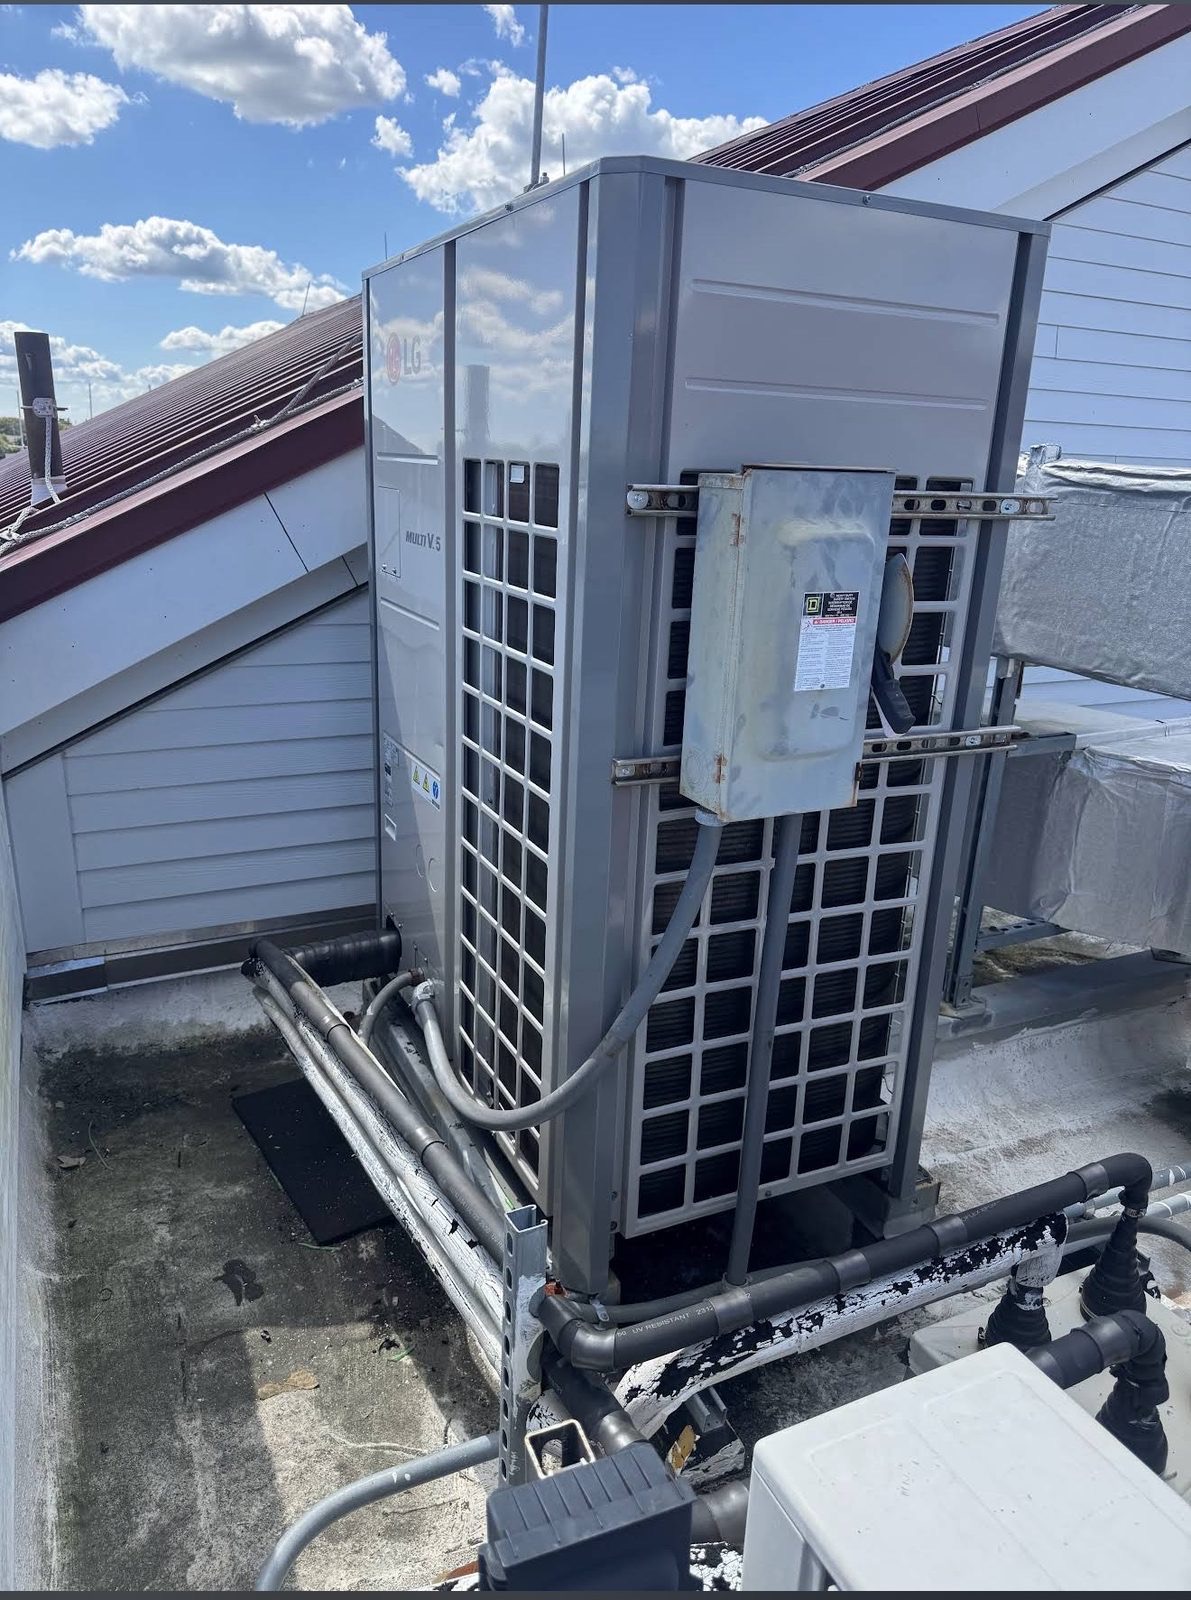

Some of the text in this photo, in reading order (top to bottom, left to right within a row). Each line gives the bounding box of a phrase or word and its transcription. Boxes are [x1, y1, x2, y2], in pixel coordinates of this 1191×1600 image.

[403, 336, 421, 375] LG
[405, 530, 427, 547] MULTI
[632, 1326, 643, 1334] UV
[645, 1312, 690, 1330] RESISTANT
